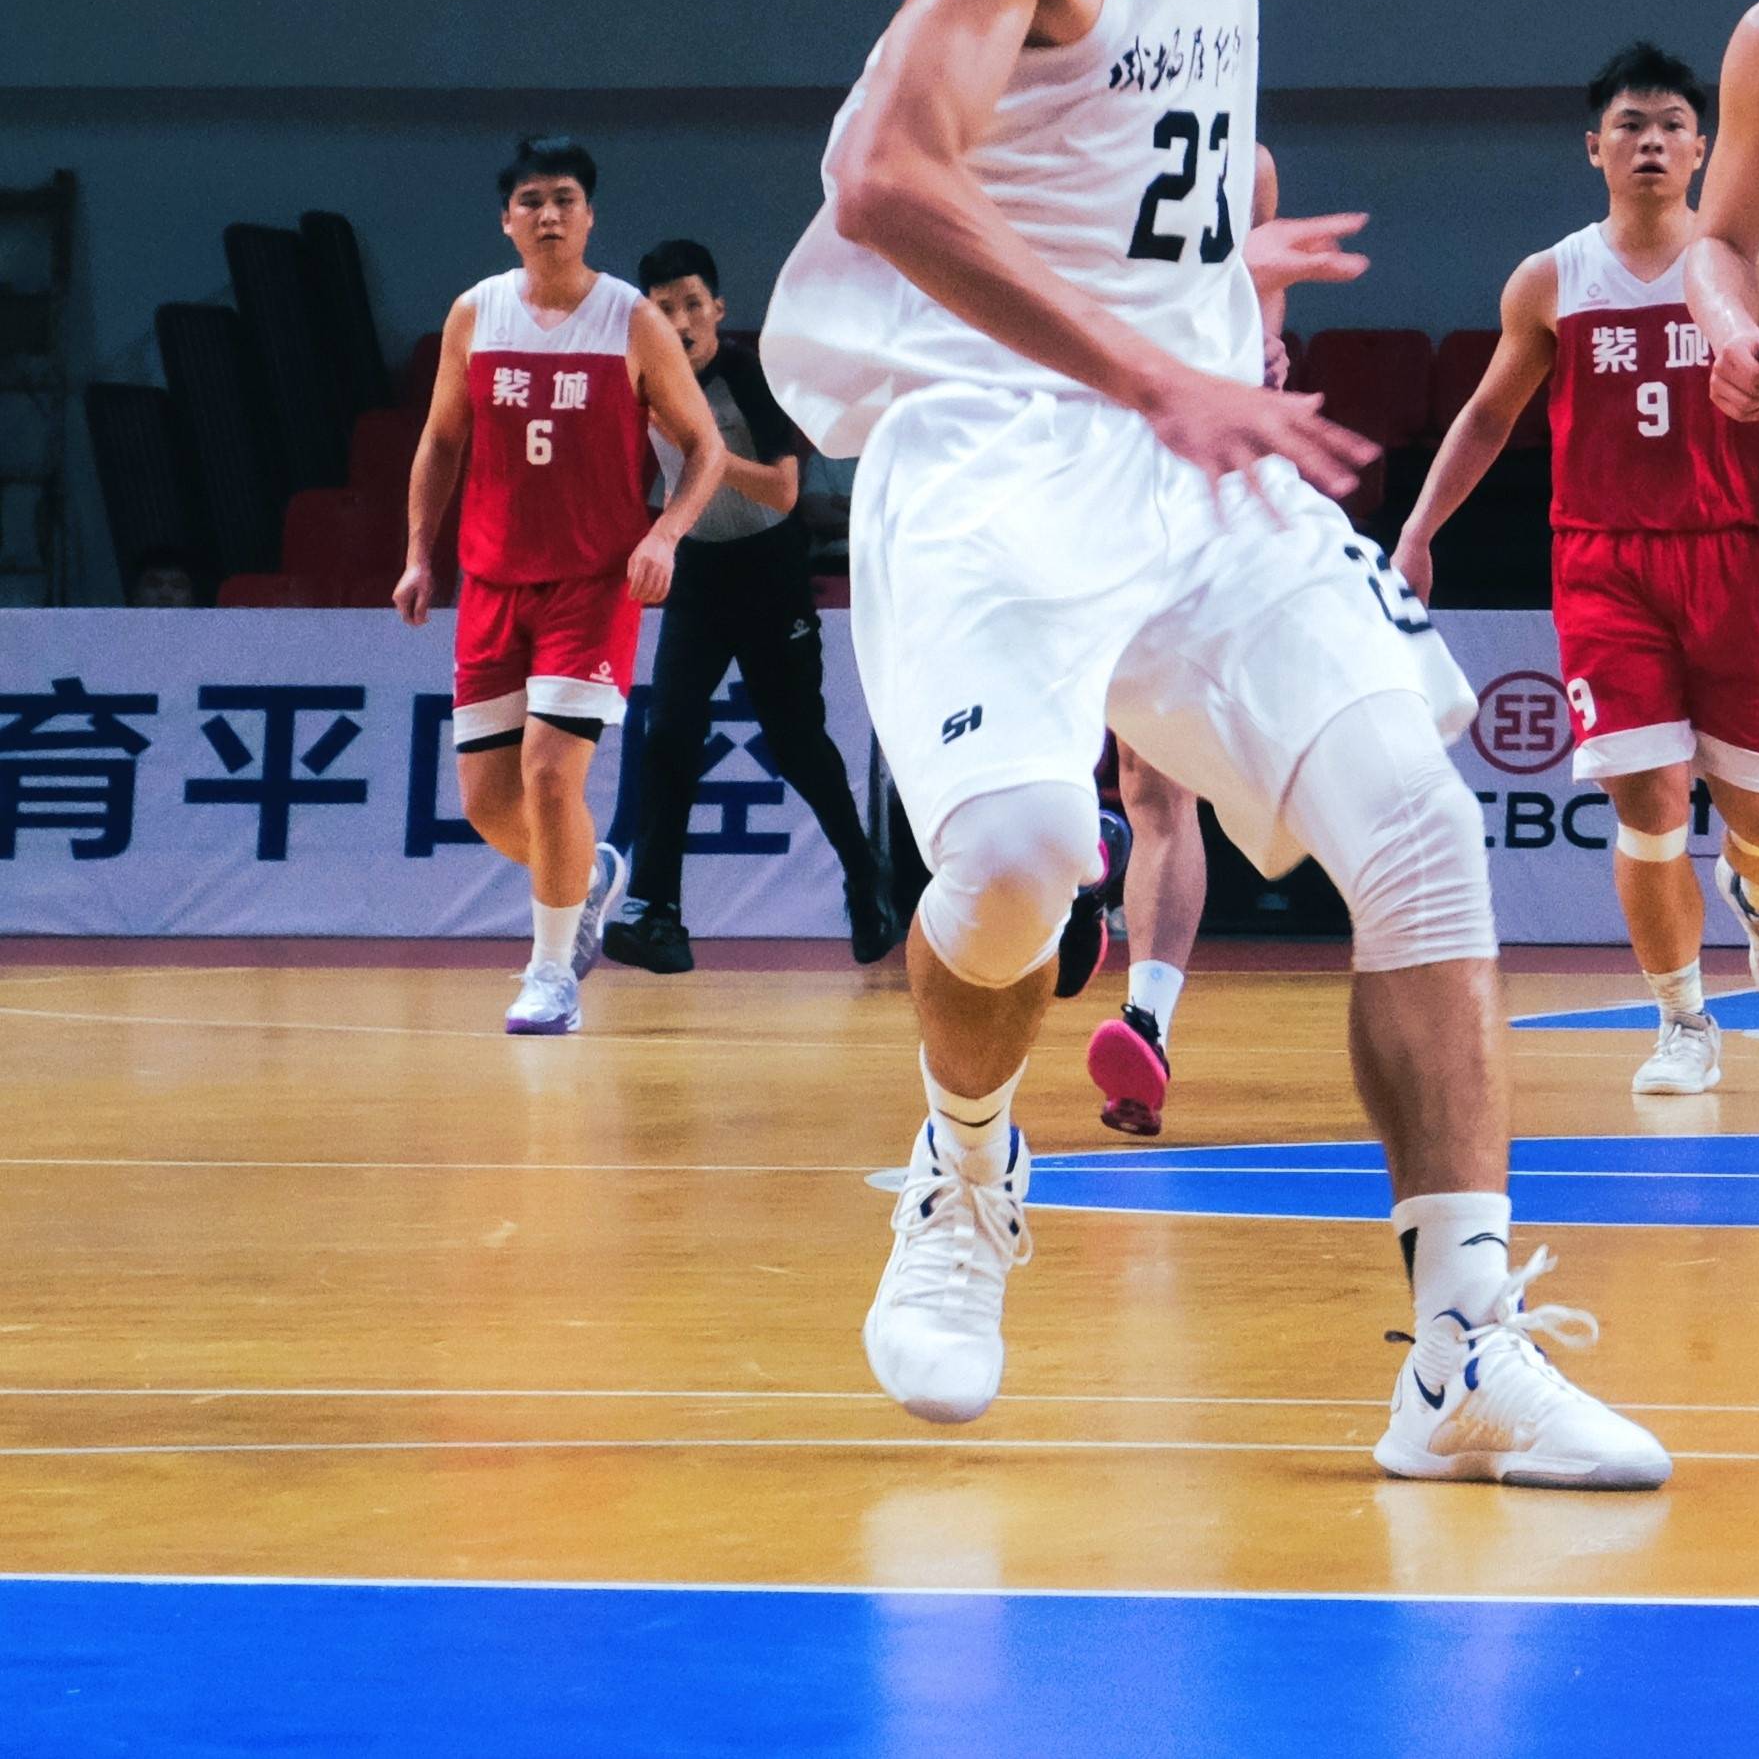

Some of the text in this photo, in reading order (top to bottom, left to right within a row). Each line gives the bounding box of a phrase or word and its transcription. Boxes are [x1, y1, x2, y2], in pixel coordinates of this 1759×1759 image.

[493, 366, 589, 410] 紫城
[1636, 382, 1669, 437] 9
[526, 420, 552, 465] 6
[1567, 677, 1598, 732] 9
